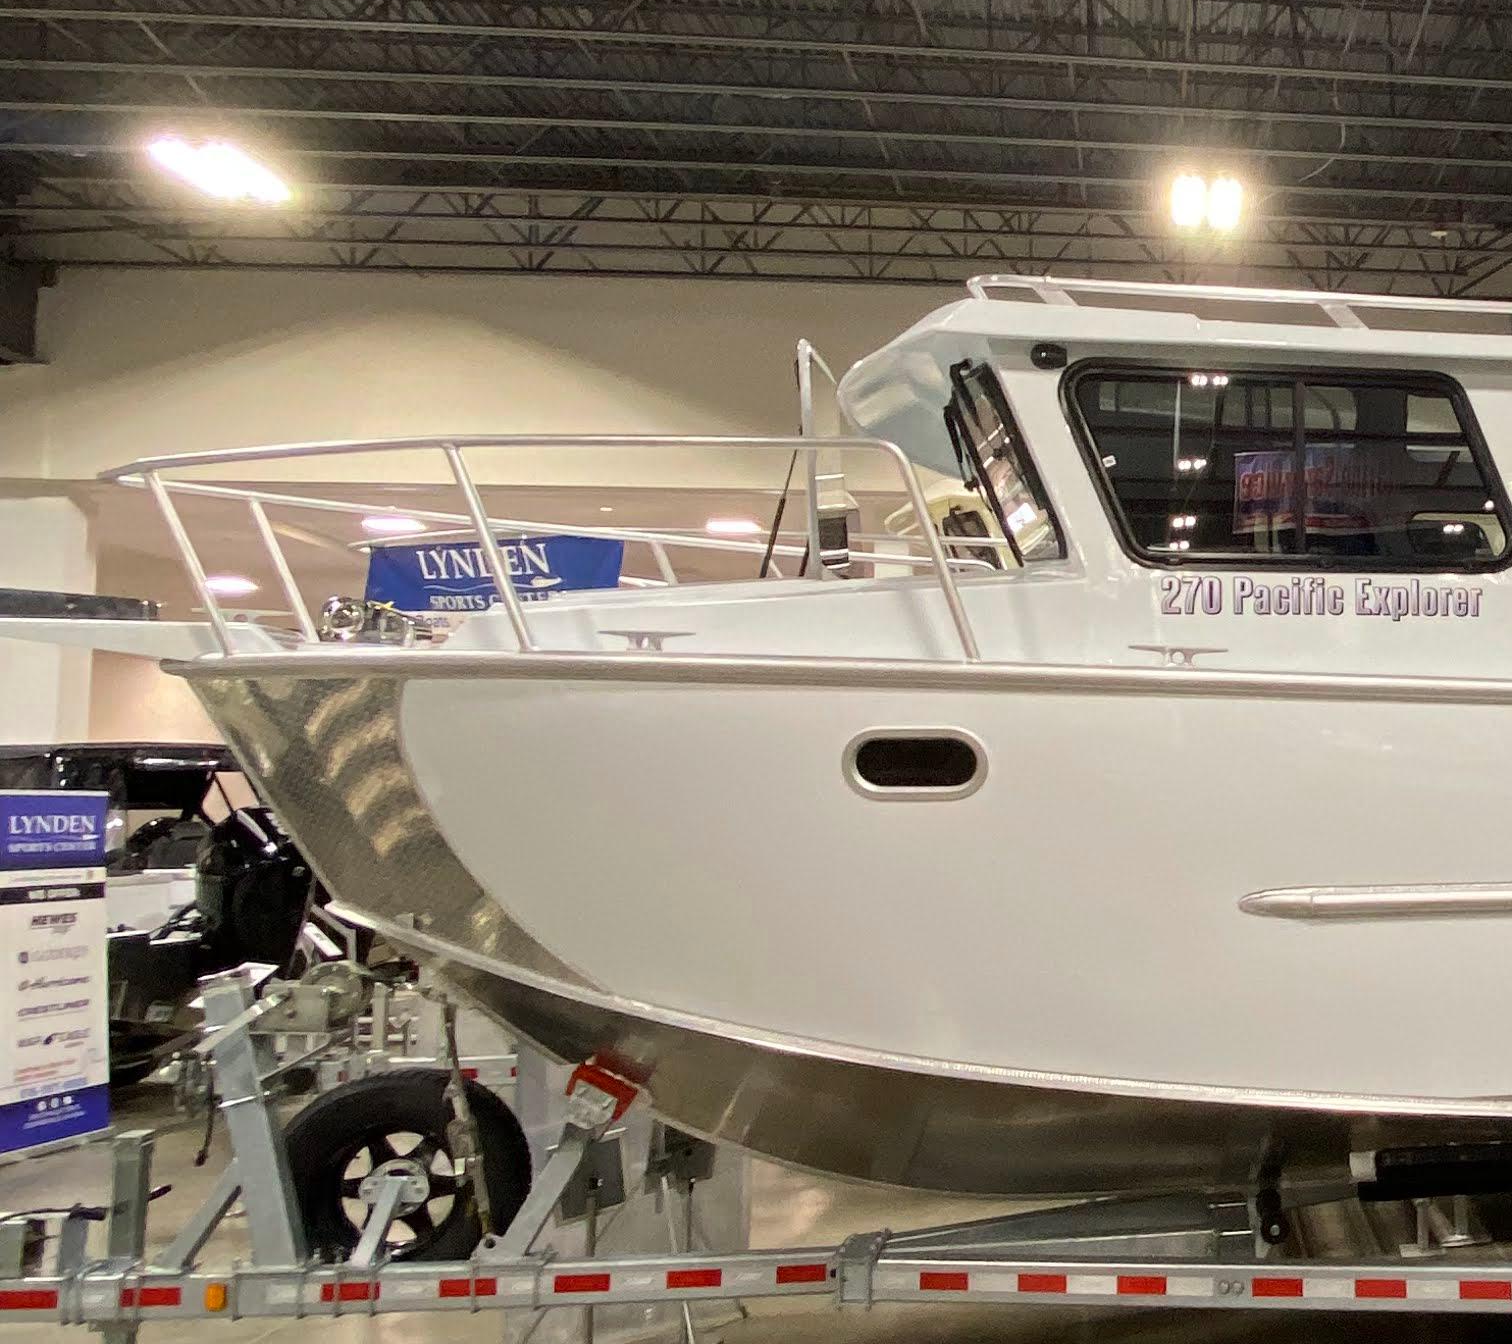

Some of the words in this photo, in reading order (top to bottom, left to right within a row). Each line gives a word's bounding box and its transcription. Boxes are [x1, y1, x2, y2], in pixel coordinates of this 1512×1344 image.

[429, 594, 485, 610] SPORTS
[1160, 575, 1223, 616] 270
[1233, 575, 1345, 616] Pacific
[1354, 577, 1483, 621] Explorer
[9, 814, 97, 835] LYNDEN
